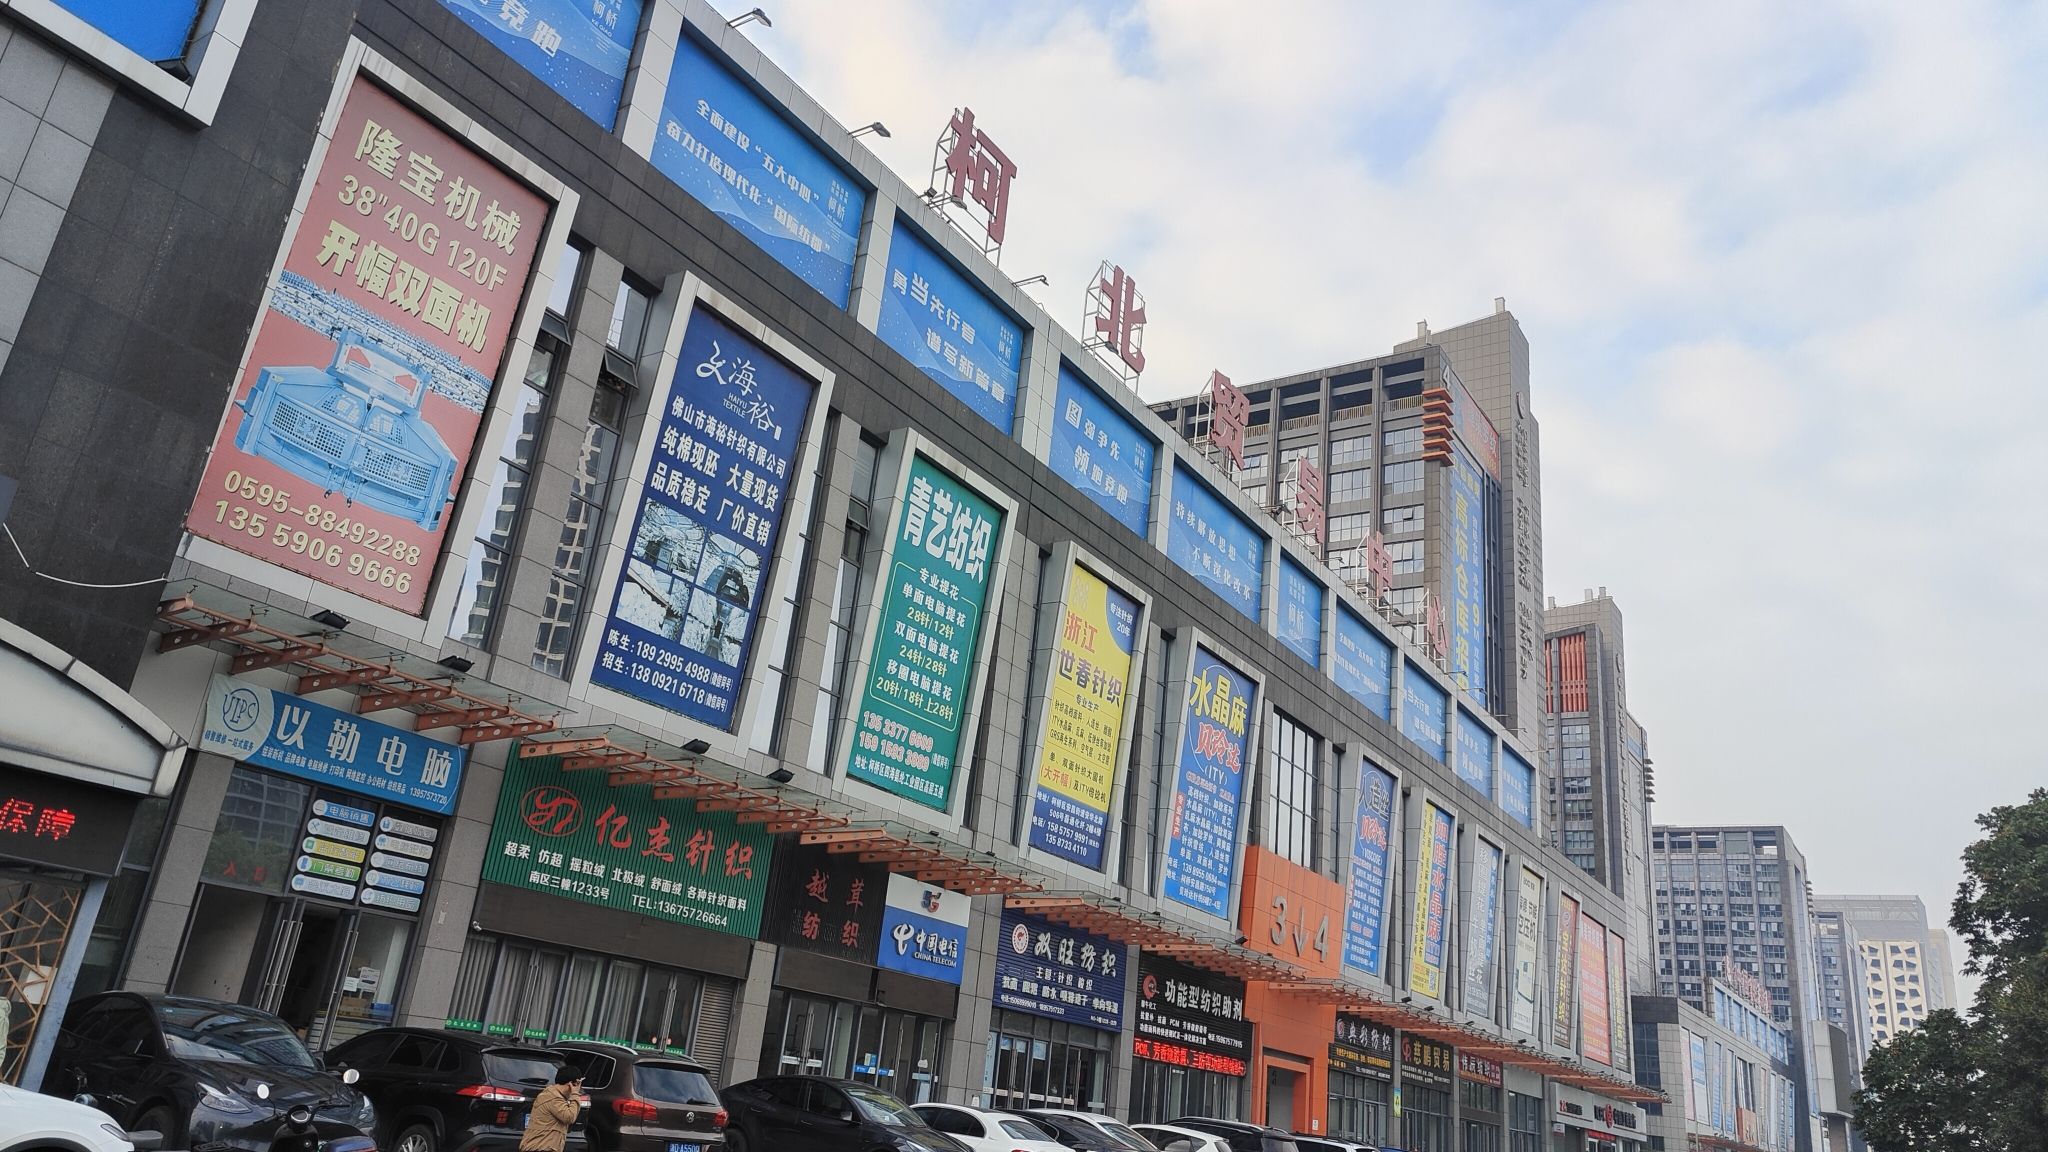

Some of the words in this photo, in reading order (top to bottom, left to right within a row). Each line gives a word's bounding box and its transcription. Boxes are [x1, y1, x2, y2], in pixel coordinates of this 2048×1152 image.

[481, 0, 562, 57] 竞跑
[354, 119, 522, 255] 隆宝机械
[316, 219, 491, 355] 开幅双面机
[446, 239, 507, 292] 120F
[723, 398, 746, 418] TEXTILE
[728, 356, 775, 432] 海裕
[728, 392, 747, 409] HAIYU
[671, 395, 787, 479] 佛山市海裕针织有限公司
[1065, 398, 1120, 462] 图强争先
[661, 425, 720, 478] 纯棉现胚
[726, 463, 779, 512] 大量现货
[224, 470, 421, 566] 0595-88492288
[650, 461, 711, 514] 品质稳定
[717, 498, 772, 548] 厂价直销
[215, 500, 268, 537] 135
[272, 523, 343, 567] 5906
[347, 554, 412, 594] 9666
[903, 476, 992, 584] 青艺纺织
[1175, 500, 1236, 562] 持续解放思想
[902, 583, 966, 628] 单面电脑提花
[919, 568, 960, 601] 专业提花
[907, 607, 955, 640] 28针/12针
[1064, 610, 1097, 654] 浙江
[1110, 602, 1133, 626] 专注针织
[1117, 621, 1131, 637] 20年
[636, 641, 655, 661] 189
[656, 649, 684, 673] 2995
[684, 662, 710, 683] 4988
[894, 621, 960, 661] 双面电脑提花
[900, 645, 948, 678] 24针/28针
[631, 662, 650, 683] 138
[652, 672, 677, 694] 0921
[678, 682, 705, 703] 6718
[886, 659, 953, 701] 移圈电脑提花
[1059, 648, 1122, 708] 世春针织
[1076, 694, 1099, 713] 专业生产
[1189, 669, 1248, 737] 水晶麻
[276, 704, 454, 789] 以勒电脑
[0, 798, 76, 841] 保障
[594, 803, 753, 880] 亿杰针织
[503, 841, 531, 860] 超柔
[538, 849, 563, 868] 仿超
[570, 856, 606, 879] 摇粒绒
[611, 867, 645, 888] 北极绒
[687, 886, 747, 912] 各种针织面料
[632, 894, 727, 927] TEL:13675726664
[802, 911, 860, 948] 纺织
[1271, 896, 1287, 945] 3
[1313, 914, 1328, 962] 4
[914, 951, 932, 962] CHINA
[932, 956, 957, 968] TELECOM
[916, 929, 959, 959] 中国电信
[1165, 979, 1242, 1021] 功能型纺织助剂
